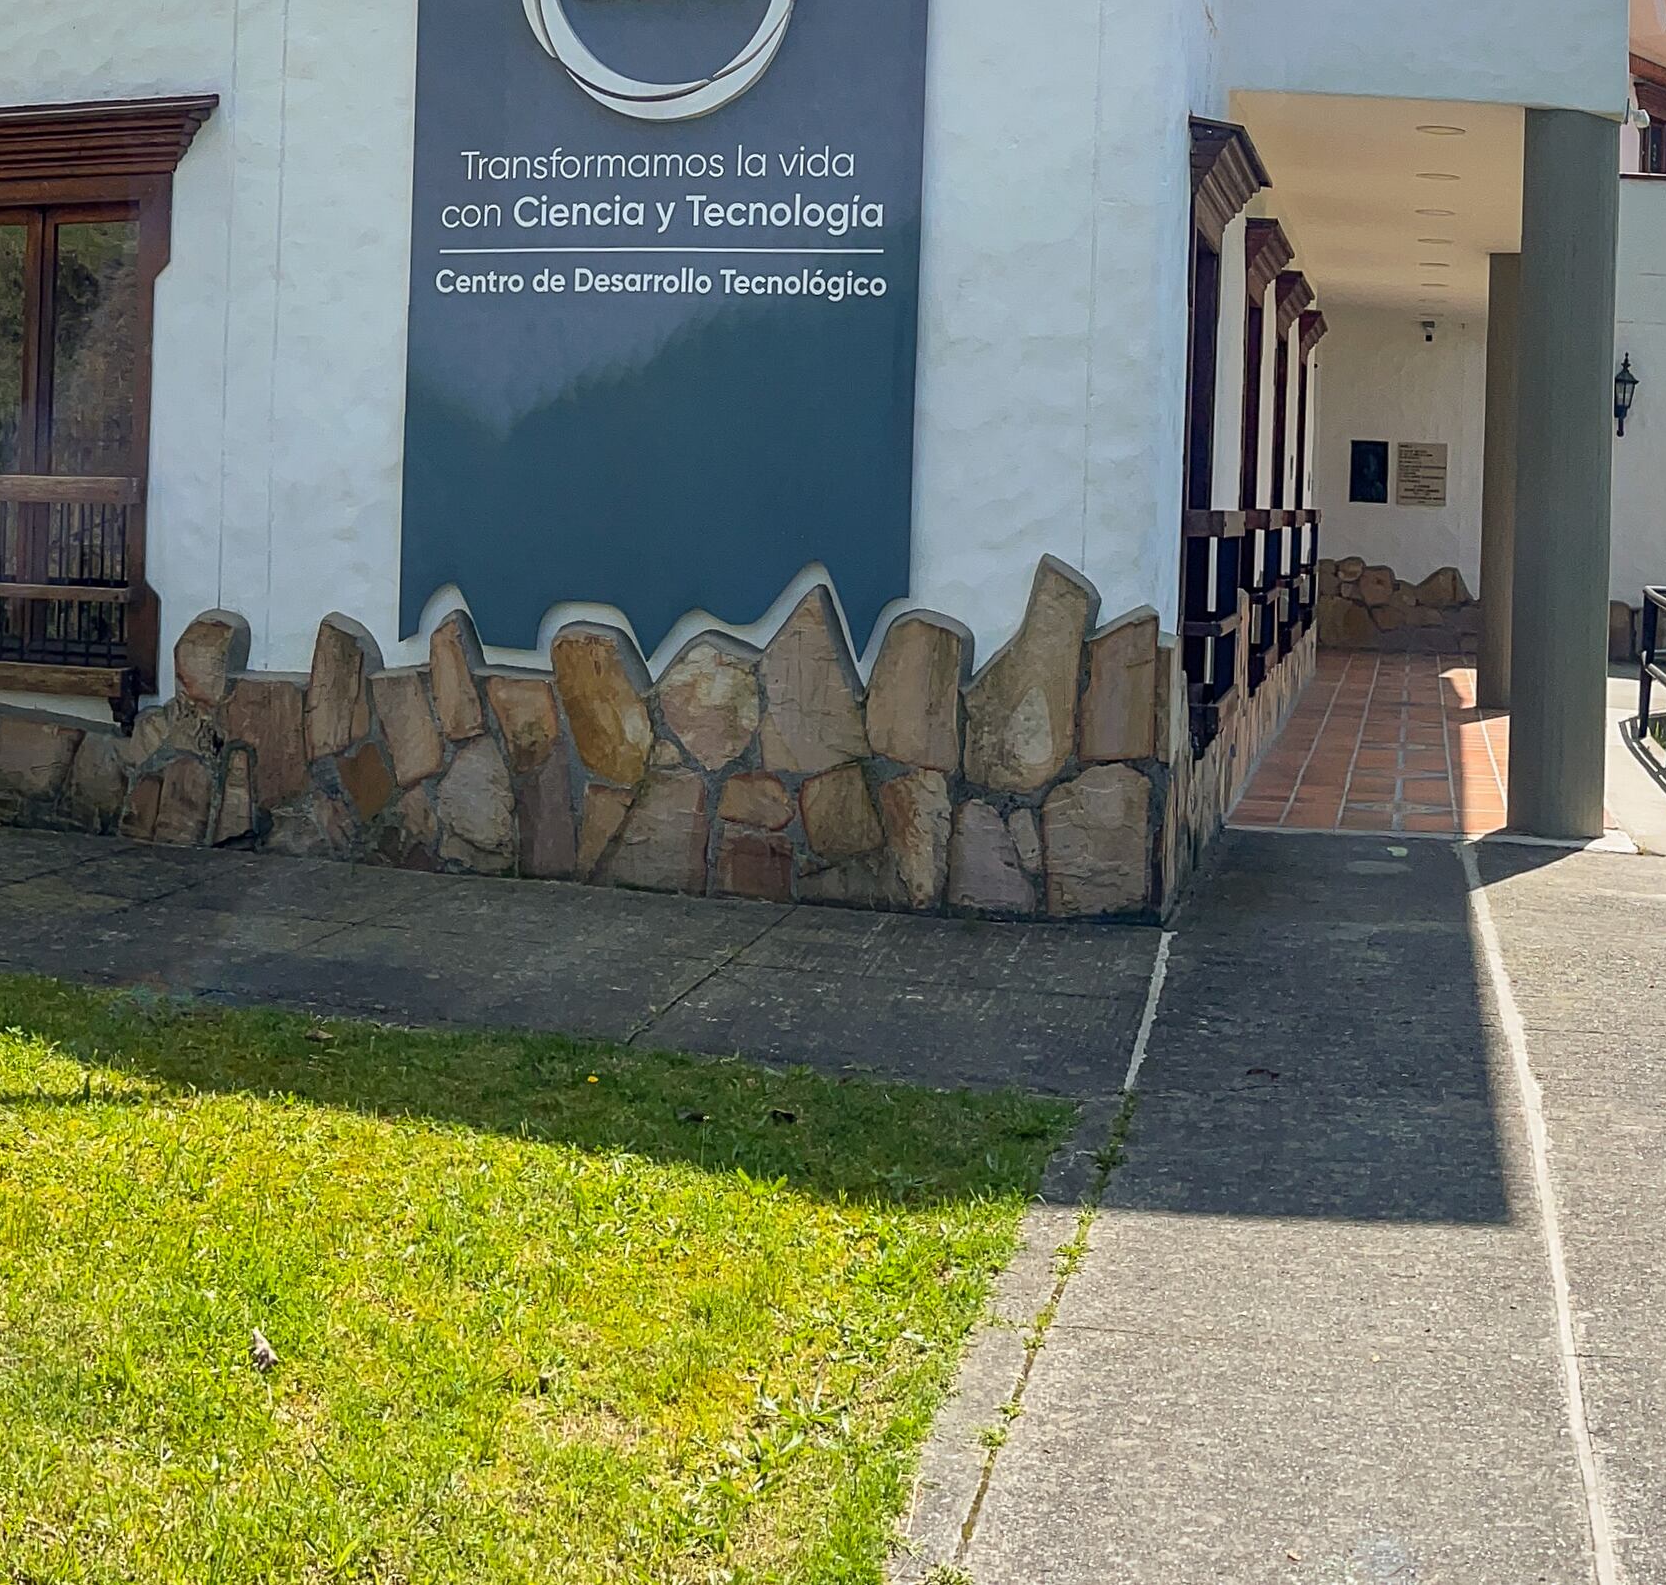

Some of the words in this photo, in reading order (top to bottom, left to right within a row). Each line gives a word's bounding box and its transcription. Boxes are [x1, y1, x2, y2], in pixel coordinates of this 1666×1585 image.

[460, 146, 725, 181] Transformamos
[737, 144, 768, 178] la
[778, 145, 856, 178] vida
[441, 204, 502, 230] con
[513, 194, 645, 229] Ciencia
[655, 201, 677, 235] y
[685, 193, 885, 237] Tecnología
[435, 269, 526, 294] Centro
[532, 268, 567, 294] de
[574, 267, 713, 295] Desarrollo
[719, 268, 888, 303] Tecnológico
